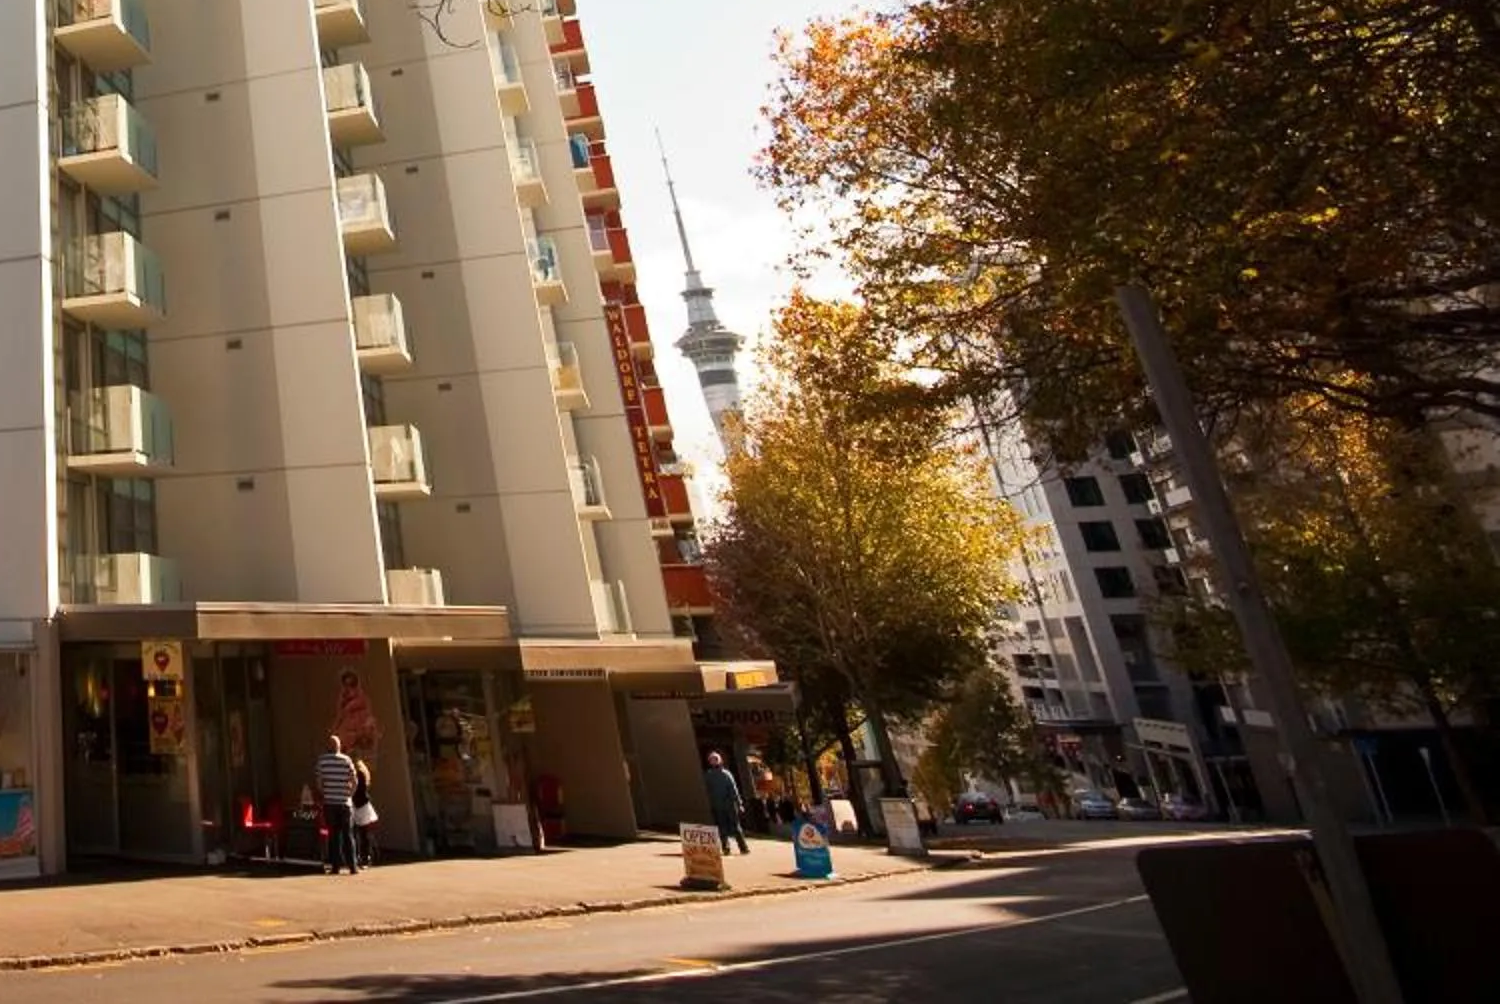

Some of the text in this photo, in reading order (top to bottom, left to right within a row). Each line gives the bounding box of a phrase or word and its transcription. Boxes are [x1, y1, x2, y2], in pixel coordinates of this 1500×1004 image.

[607, 309, 658, 499] WALDORF TETRA
[705, 708, 776, 726] LIQUOR
